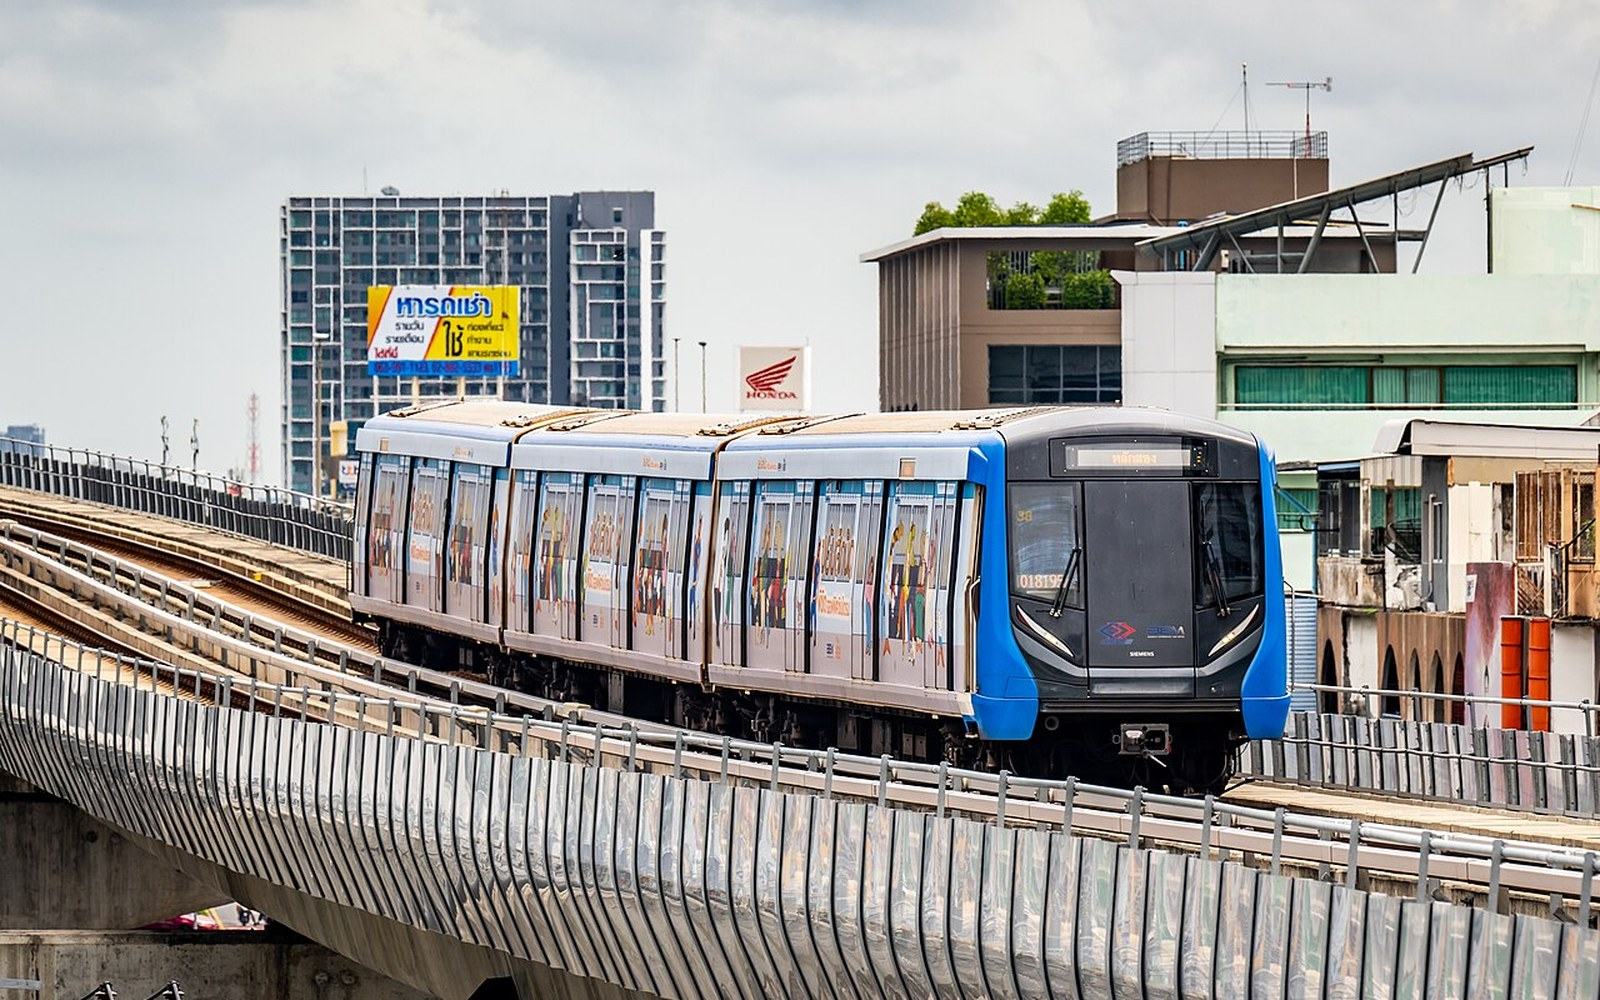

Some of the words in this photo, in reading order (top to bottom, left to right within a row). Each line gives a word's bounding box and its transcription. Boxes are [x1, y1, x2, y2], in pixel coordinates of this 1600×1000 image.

[396, 293, 491, 316] หารถเช่า
[443, 321, 464, 357] ใช้
[746, 391, 797, 399] HONDA
